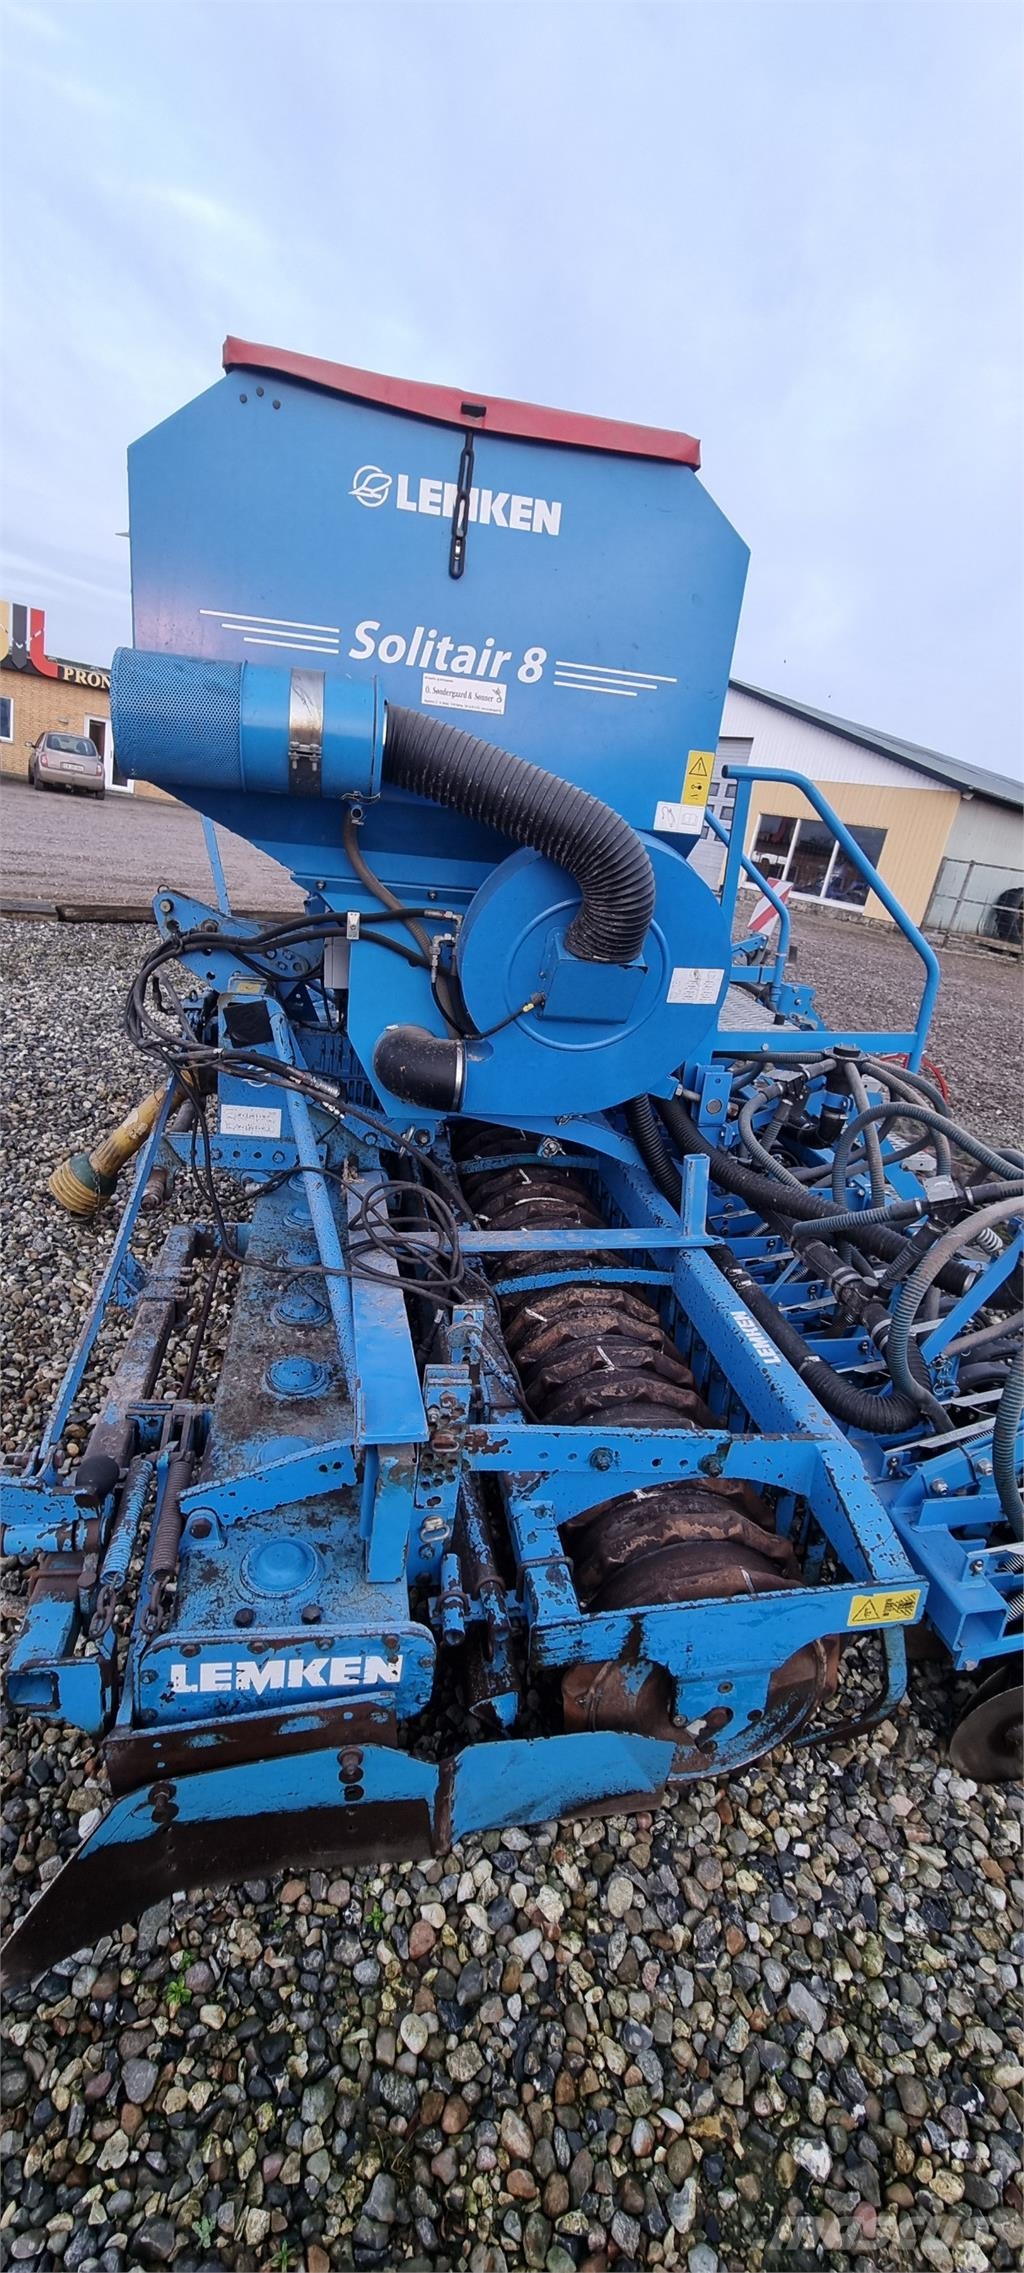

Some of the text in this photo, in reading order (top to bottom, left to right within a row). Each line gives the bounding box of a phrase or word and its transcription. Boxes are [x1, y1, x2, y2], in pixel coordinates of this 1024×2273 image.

[348, 619, 548, 684] Solitair 8
[729, 1310, 782, 1364] LEMKEN
[170, 1653, 404, 1696] LEMKEN
